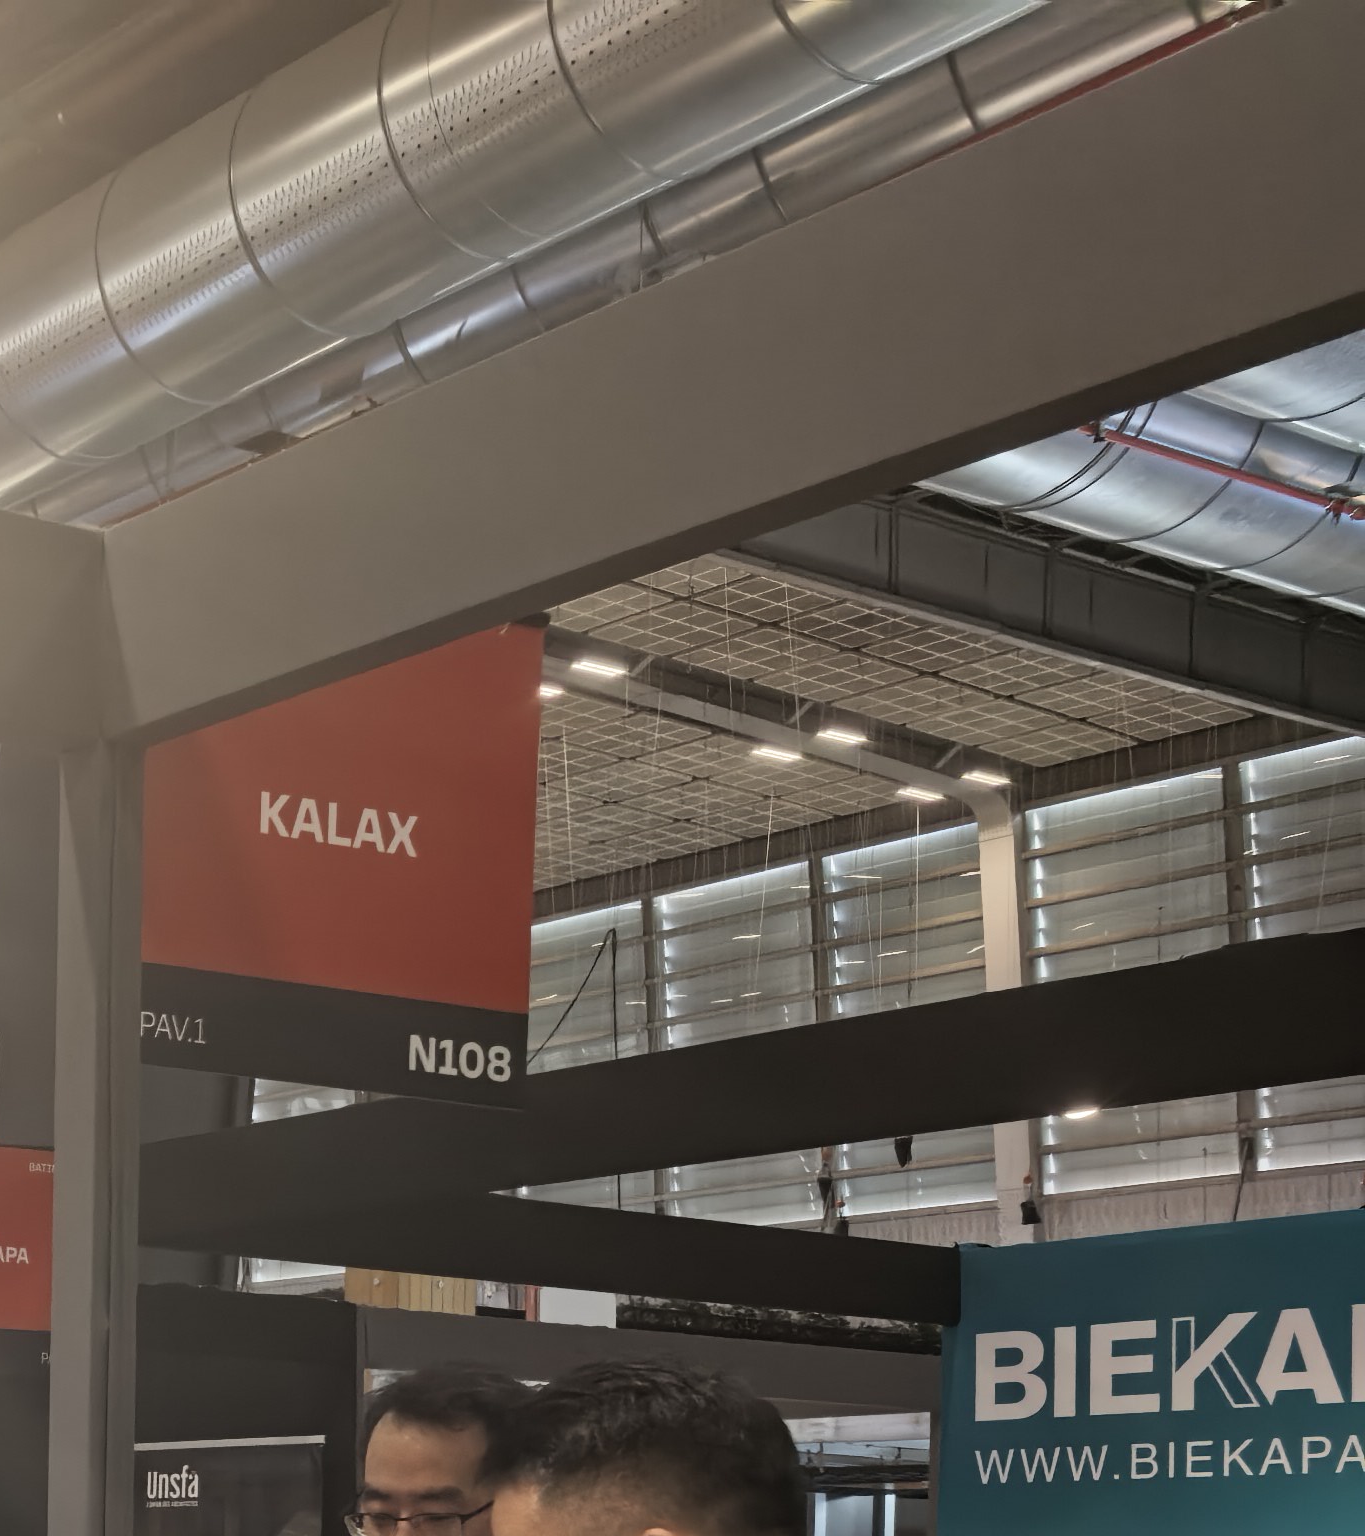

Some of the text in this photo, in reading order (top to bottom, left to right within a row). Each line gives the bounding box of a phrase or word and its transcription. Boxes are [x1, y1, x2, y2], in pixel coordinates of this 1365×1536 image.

[259, 791, 418, 858] KALAX
[141, 1011, 206, 1045] PAV.1
[408, 1034, 512, 1082] N108
[974, 1303, 1365, 1423] BIEKA
